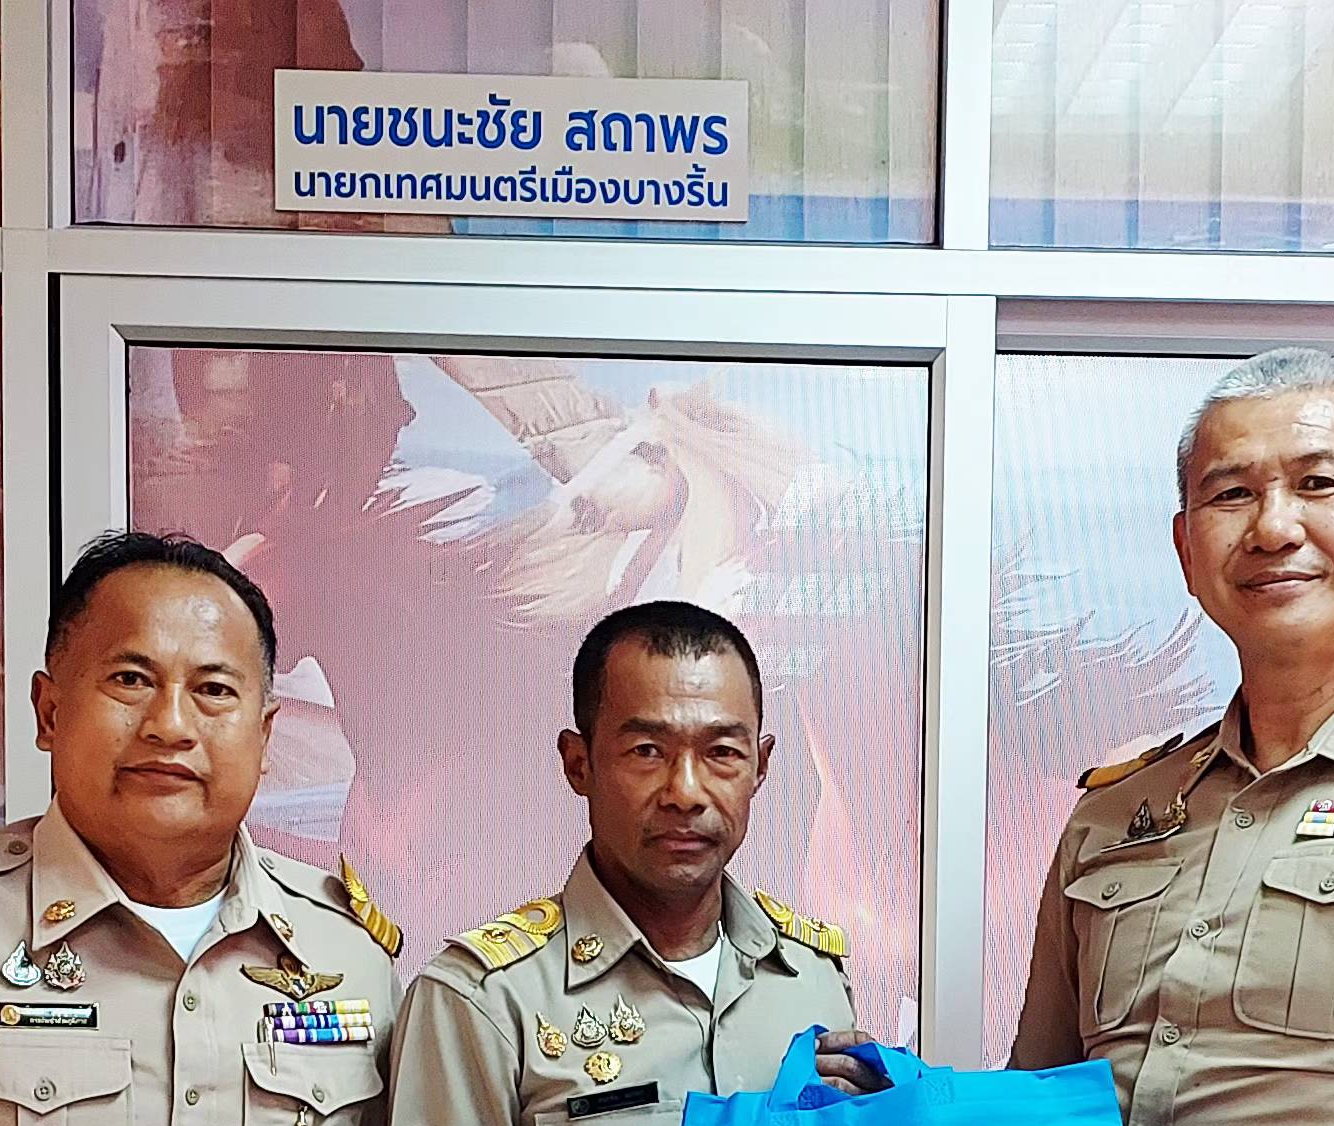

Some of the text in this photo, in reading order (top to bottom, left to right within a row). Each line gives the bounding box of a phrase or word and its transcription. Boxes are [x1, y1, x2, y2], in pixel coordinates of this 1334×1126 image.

[294, 94, 729, 156] นายชนะชัย สถาพร
[294, 163, 729, 208] นายกเทศมนตรีเมืองบางริ้น
